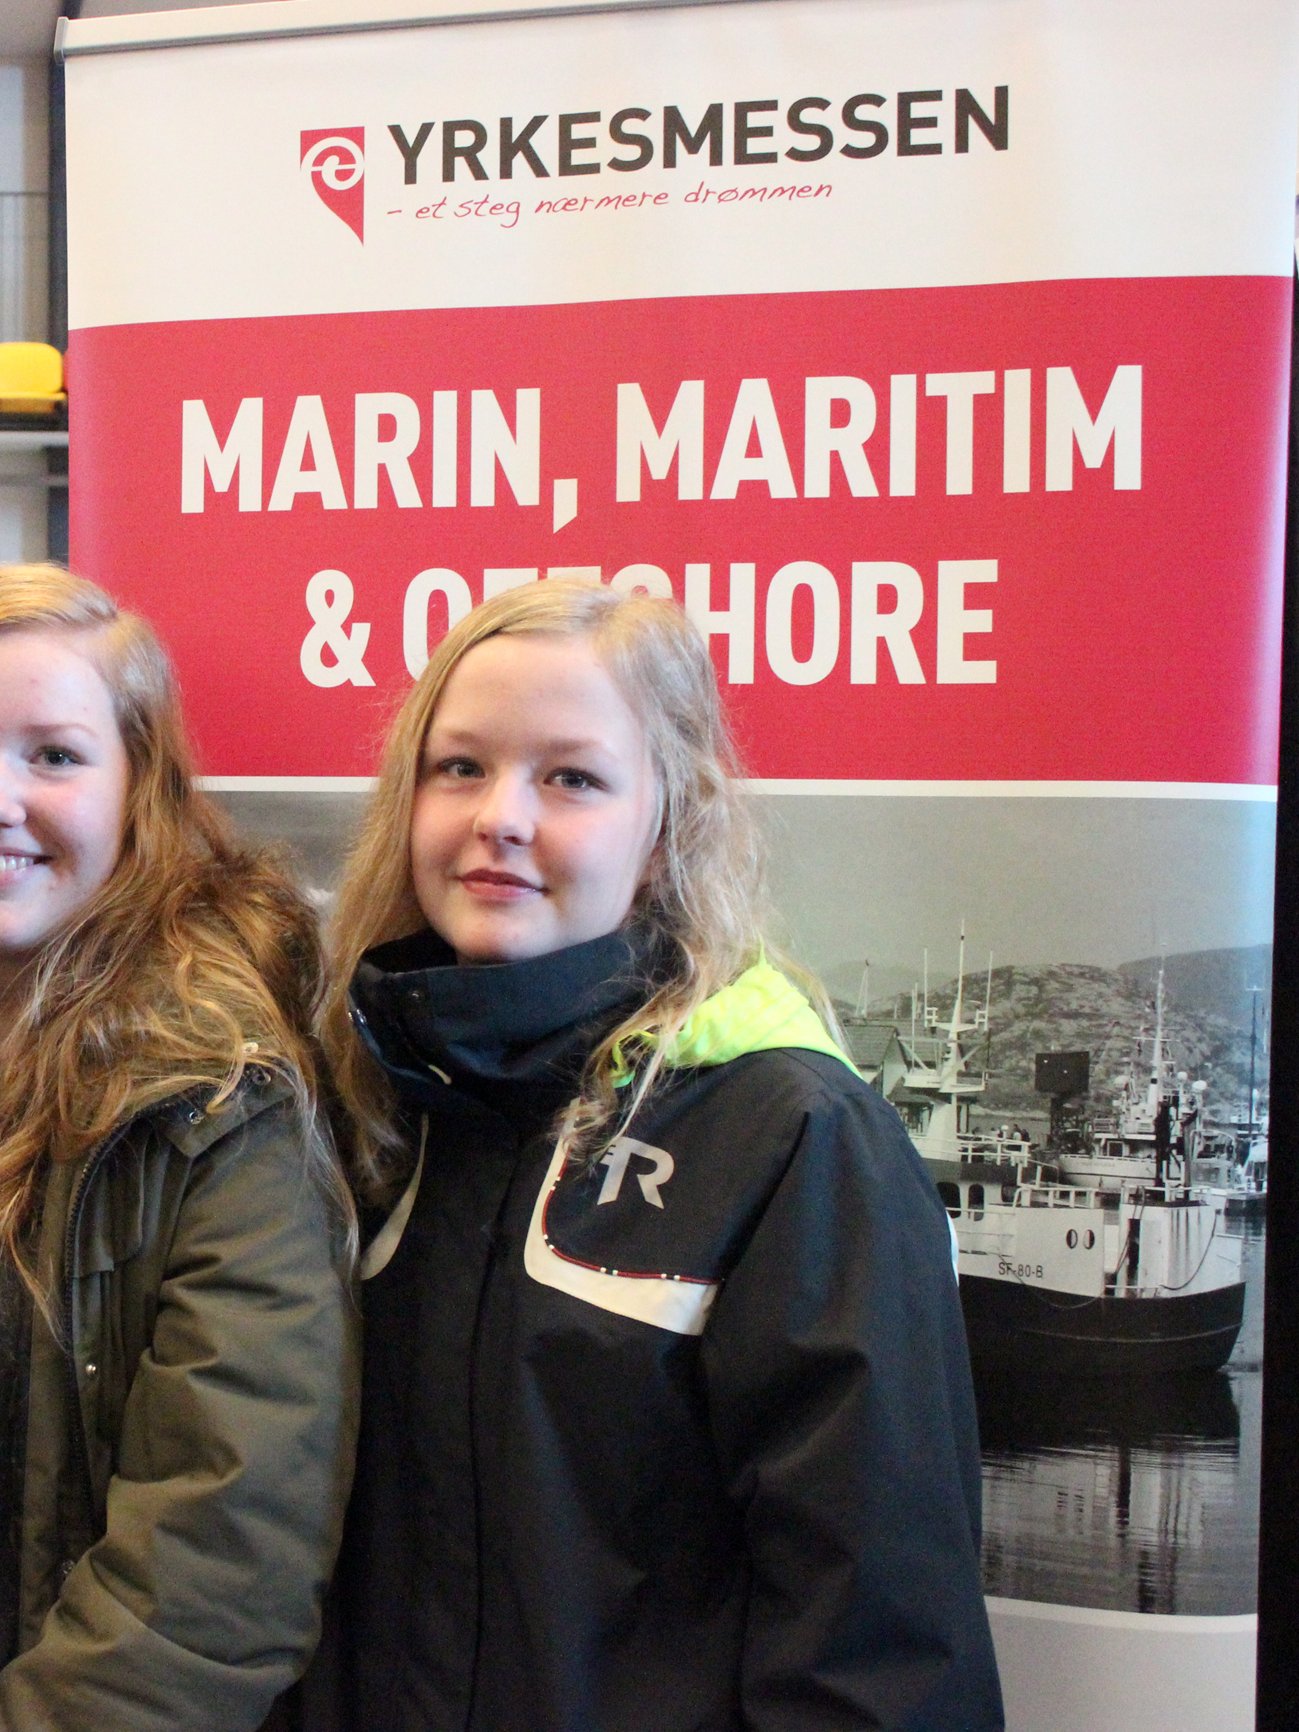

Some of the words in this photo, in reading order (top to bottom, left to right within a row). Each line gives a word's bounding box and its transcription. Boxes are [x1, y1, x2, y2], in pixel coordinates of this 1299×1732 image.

[386, 84, 1010, 184] YRKESMESSEN
[415, 196, 448, 220] et
[453, 194, 521, 229] steg
[534, 191, 669, 216] nærmere
[683, 181, 834, 205] drømmen
[180, 386, 579, 534] MARIN,
[615, 363, 1144, 503] MARITIM
[299, 568, 377, 688] &
[402, 558, 999, 686] OHORE
